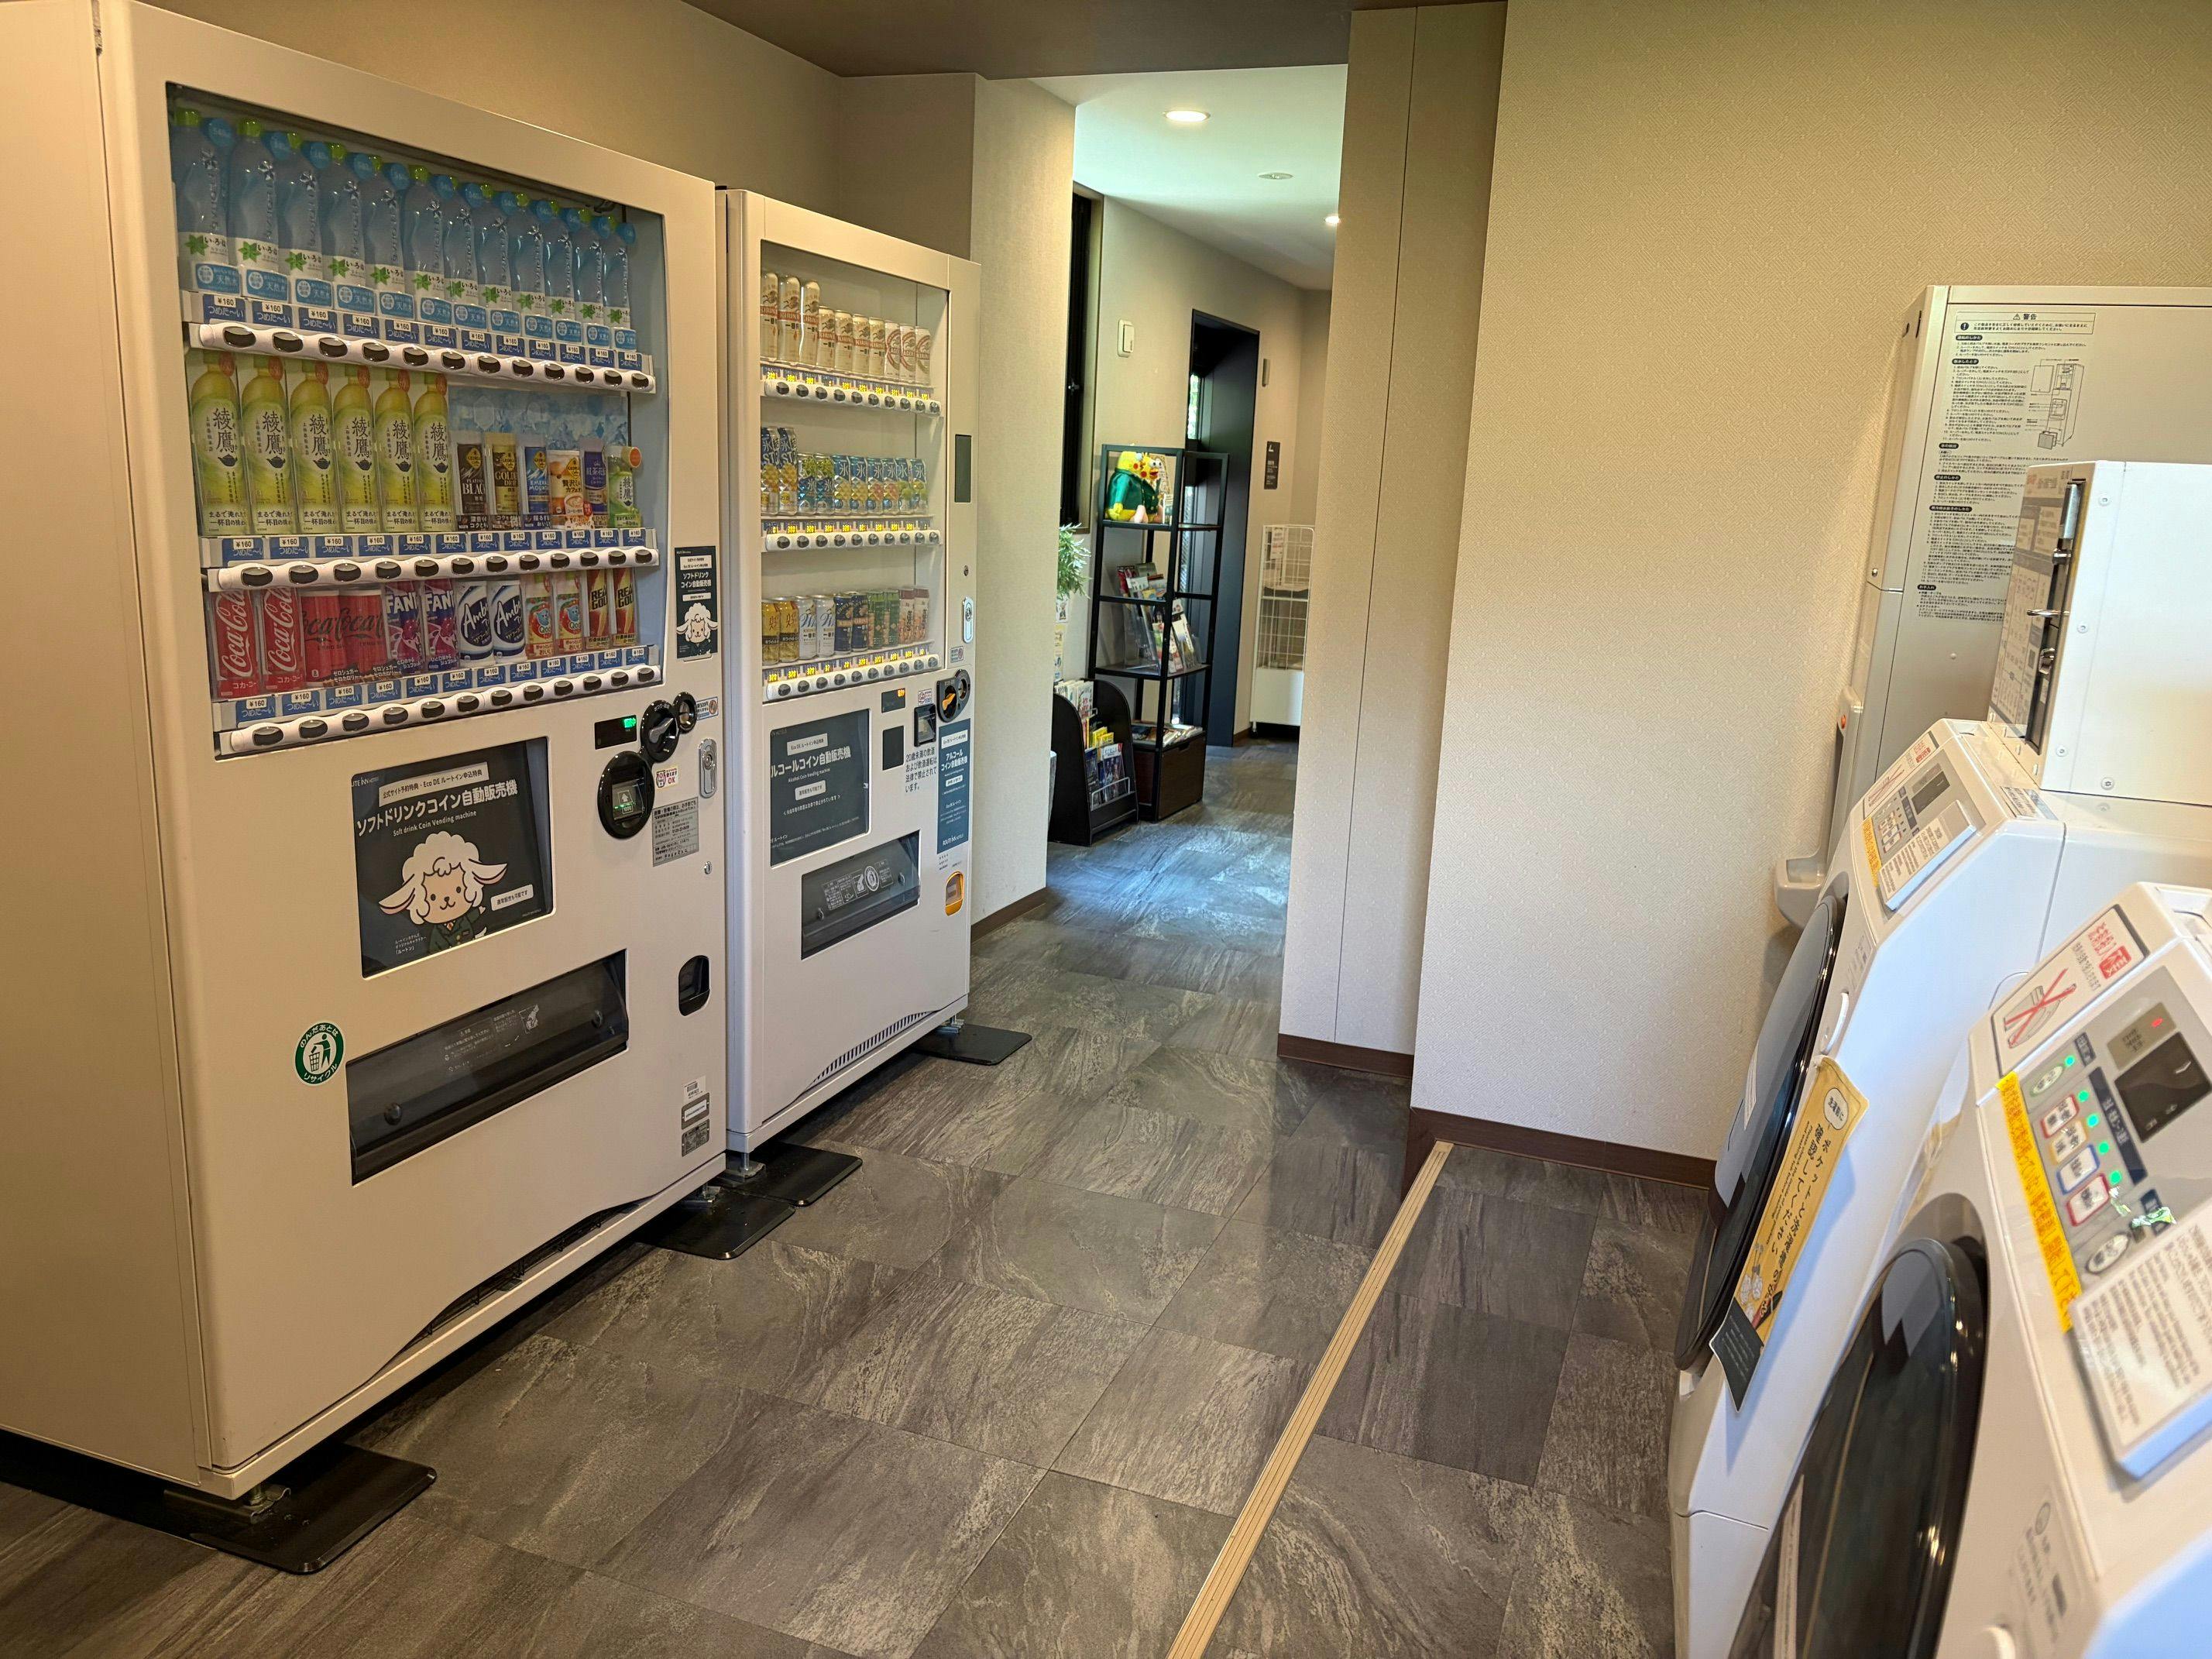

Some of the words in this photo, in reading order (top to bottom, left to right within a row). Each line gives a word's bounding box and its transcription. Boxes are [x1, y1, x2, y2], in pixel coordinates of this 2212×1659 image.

[213, 407, 234, 454] 綾鷹
[263, 411, 283, 454] 綾鷹
[310, 414, 328, 455] 綾鷹
[352, 417, 370, 458] 綾鷹
[393, 420, 409, 459] 綾鷹
[431, 423, 446, 461] 綾鷹
[906, 747, 935, 762] 20歳未満の飲酒
[906, 756, 937, 772] および飲酒運転は
[905, 767, 936, 783] 法律で禁止されて
[357, 779, 518, 836] ソフトドリンクコイン自動販売機
[404, 824, 418, 833] drink
[418, 821, 431, 830] Coin
[432, 816, 455, 826] Vending
[455, 810, 477, 821] machine
[301, 1025, 338, 1048] のんだあとは
[304, 1064, 337, 1082] リサイクル
[1772, 1123, 1824, 1255] 確認してください
